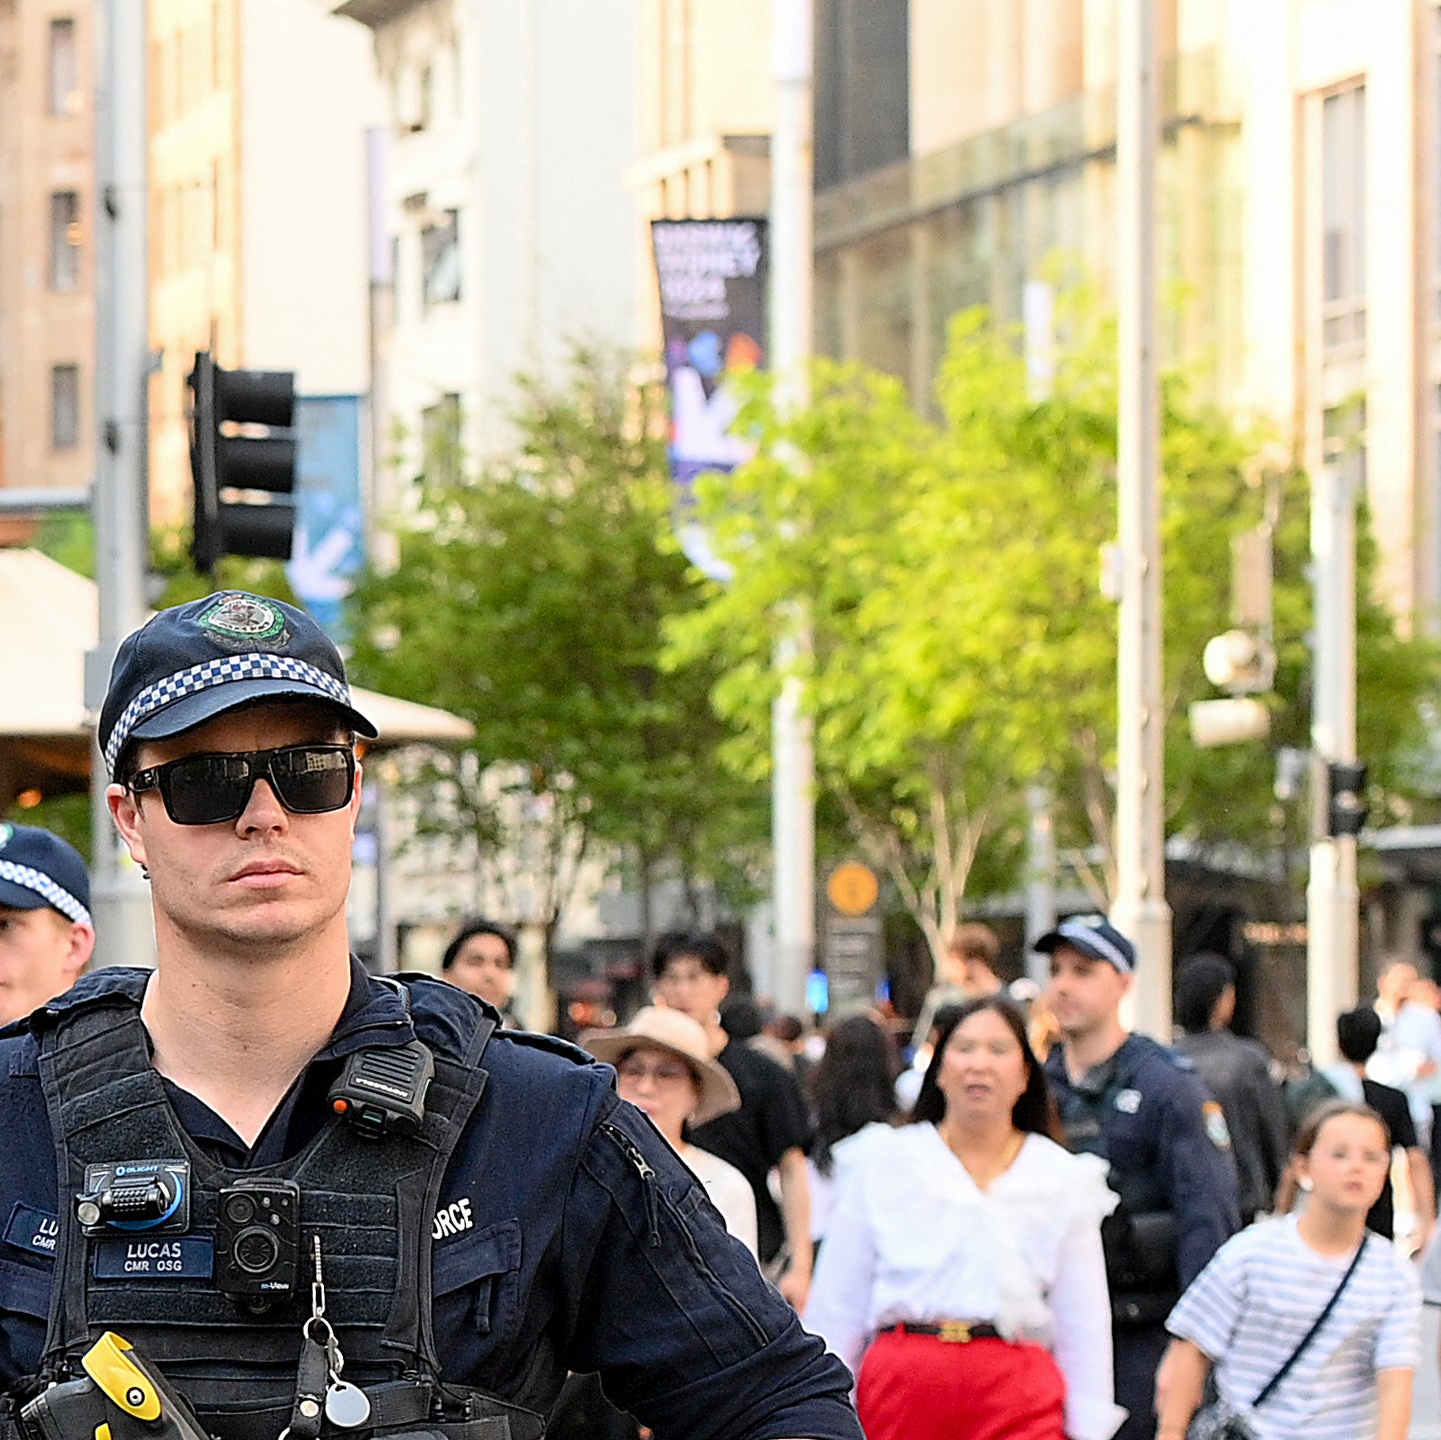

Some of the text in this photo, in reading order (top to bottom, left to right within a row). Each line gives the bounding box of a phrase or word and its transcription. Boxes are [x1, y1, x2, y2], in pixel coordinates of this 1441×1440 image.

[126, 1242, 182, 1259] LUCAS
[124, 1260, 183, 1272] CMR OSG
